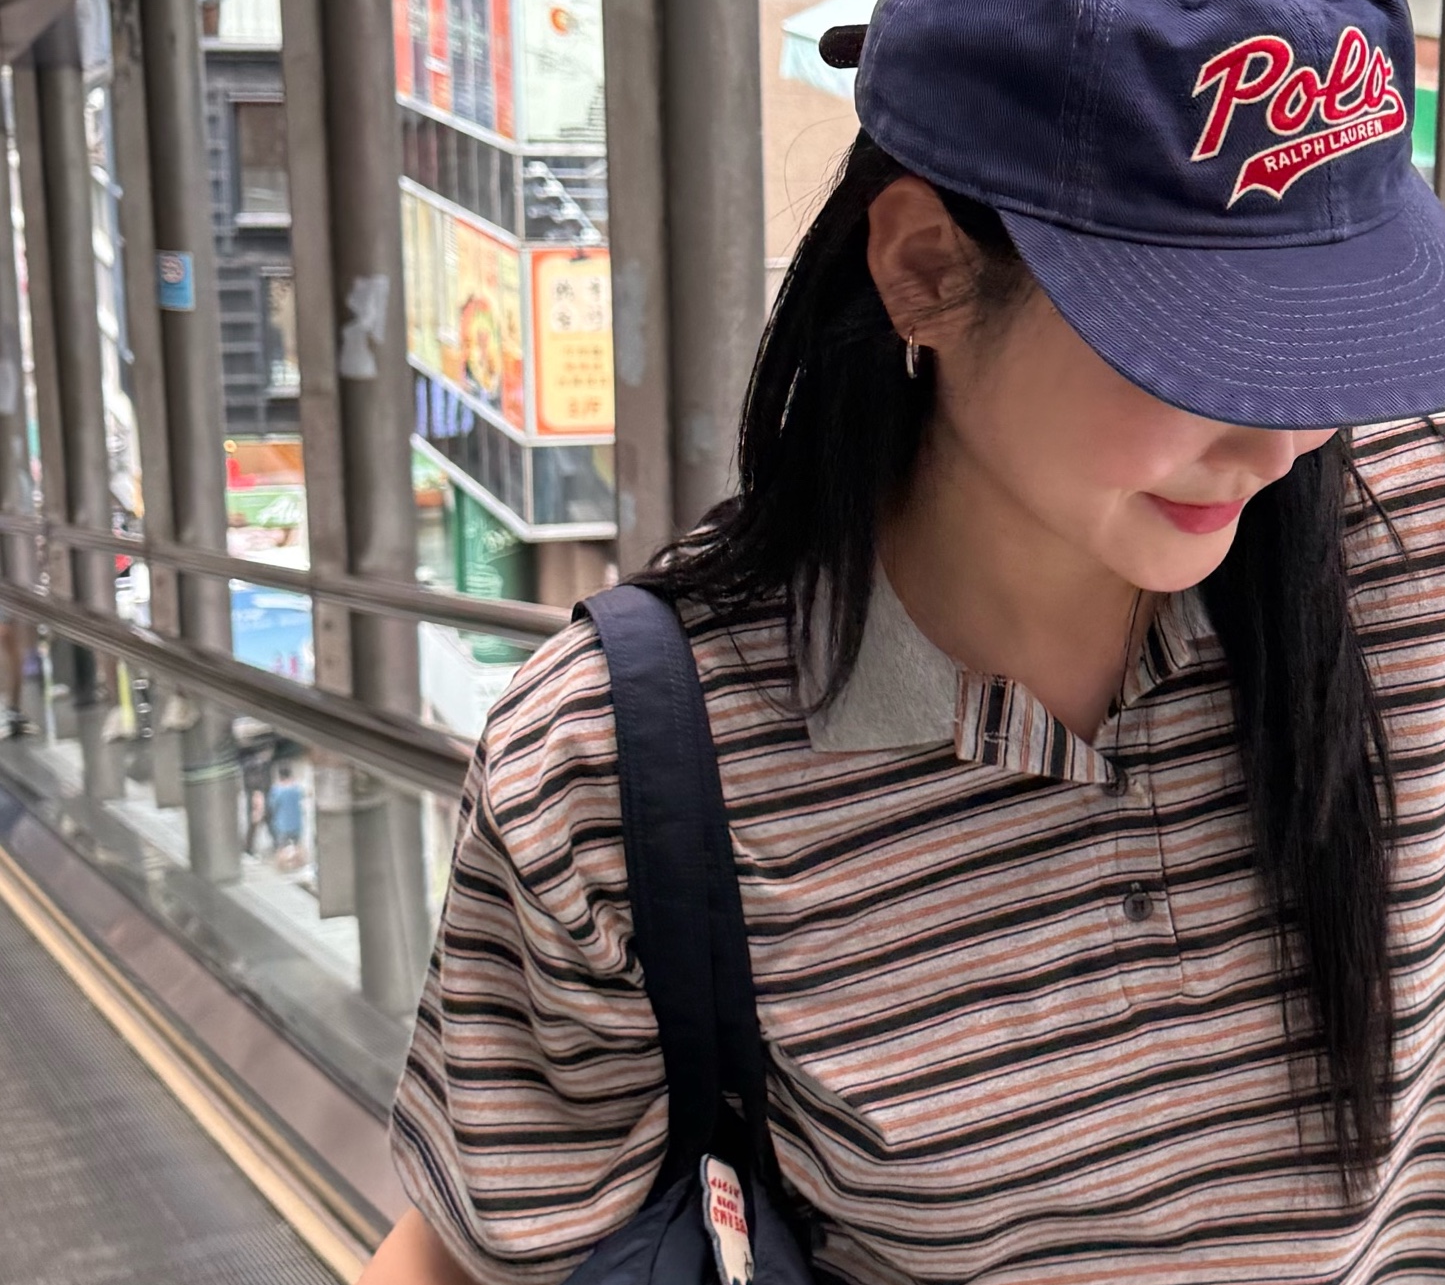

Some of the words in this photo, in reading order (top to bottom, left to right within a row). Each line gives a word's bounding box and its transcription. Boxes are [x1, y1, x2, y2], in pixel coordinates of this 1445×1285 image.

[1190, 26, 1394, 163] Polo
[1262, 137, 1325, 173] RALPH
[1330, 119, 1384, 150] LAUREN
